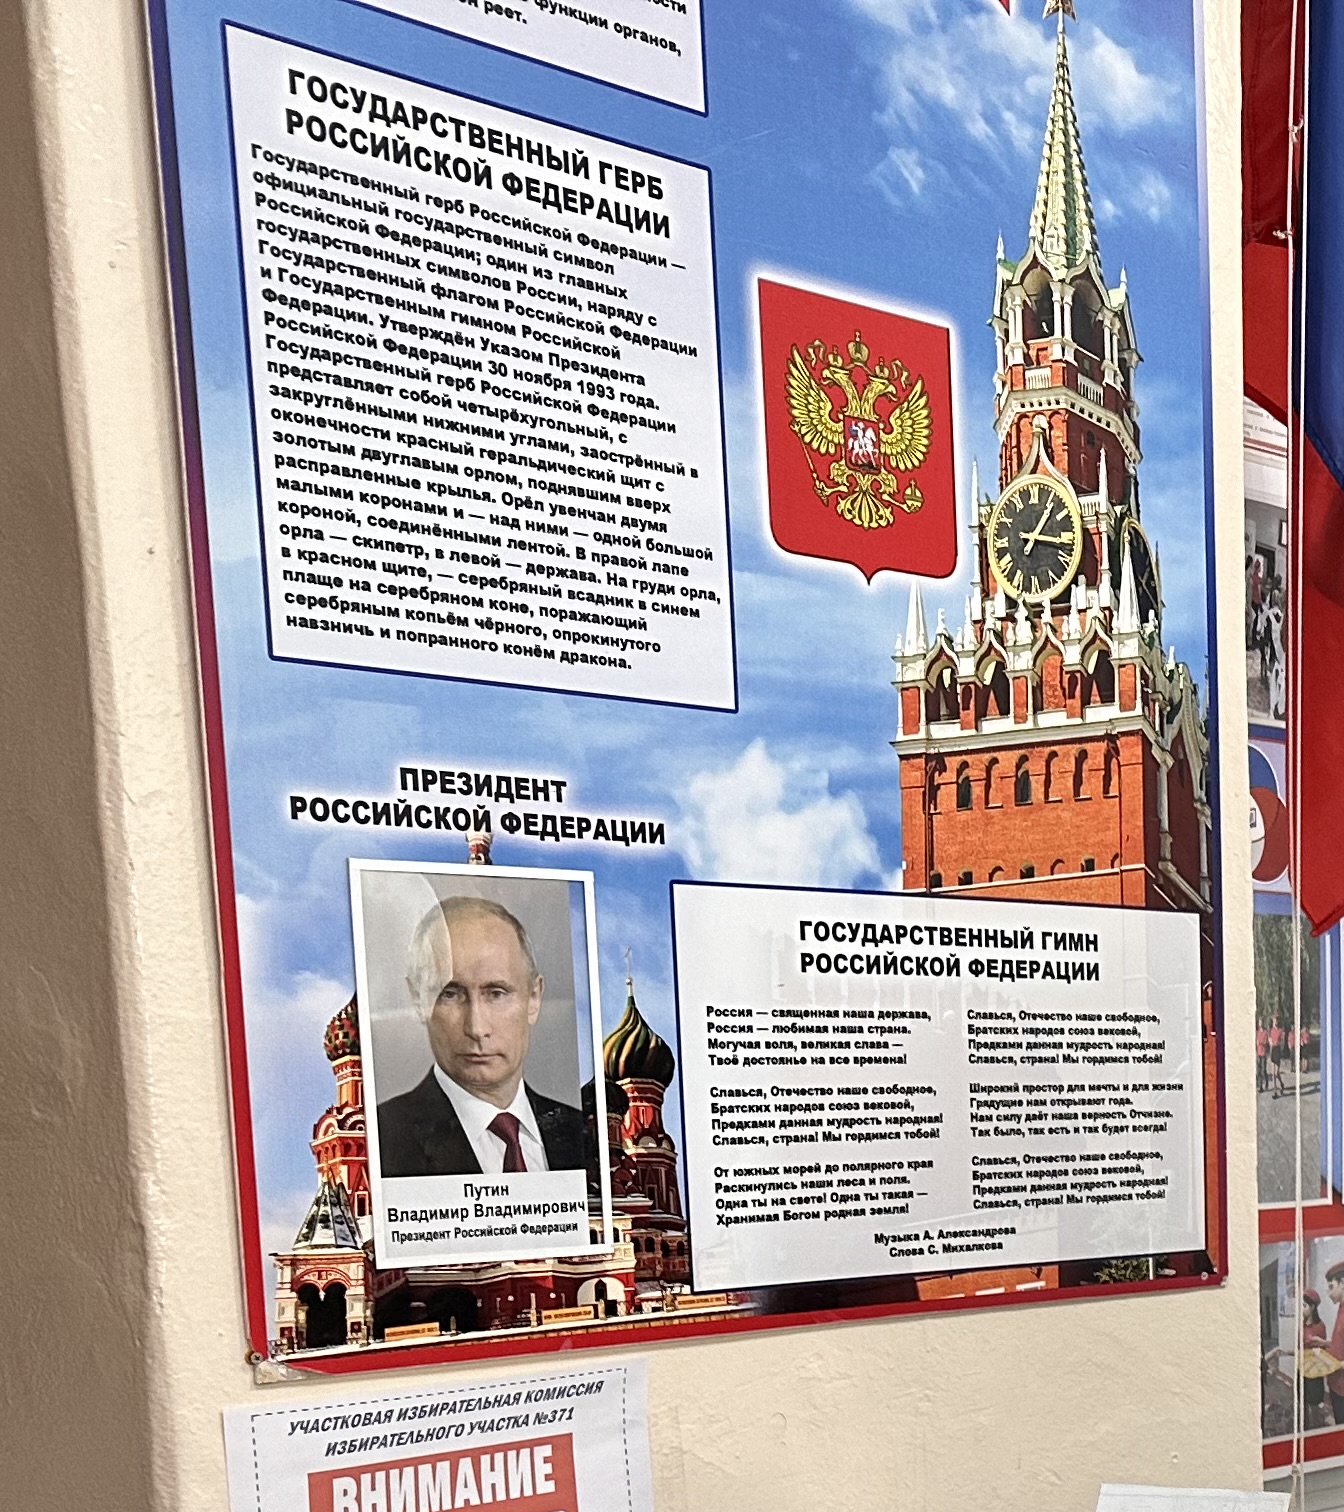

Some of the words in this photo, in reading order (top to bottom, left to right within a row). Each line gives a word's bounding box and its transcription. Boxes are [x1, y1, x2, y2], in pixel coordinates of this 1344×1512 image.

[484, 1, 528, 24] реет.
[613, 22, 682, 56] органов,
[287, 67, 590, 181] ГОСУДАРСТВЕННЫЙ
[597, 159, 664, 201] ГЕРБ
[284, 107, 493, 191] РОССИЙСКОЙ
[500, 171, 671, 239] ФЕДЕРАЦИИ
[249, 142, 420, 203] Государственный
[424, 193, 465, 215] герб
[468, 201, 573, 244] Российской
[575, 231, 668, 269] Федерации
[251, 170, 390, 218] официальный
[393, 207, 549, 259] государственный
[552, 249, 615, 276] символ
[253, 190, 371, 235] Российской
[374, 223, 482, 267] Федерации;
[485, 253, 528, 275] один
[531, 265, 554, 281] из
[557, 271, 629, 300] главных
[255, 217, 422, 270] государственных
[425, 260, 512, 292] символов
[515, 278, 583, 313] России,
[586, 299, 644, 327] наряду
[646, 314, 658, 327] с
[257, 238, 426, 294] Государственный
[429, 281, 500, 311] флагом
[502, 297, 605, 336] Российской
[608, 324, 698, 358] Федерации
[259, 265, 272, 280] и
[276, 265, 446, 321] Государственным
[449, 310, 517, 337] гимном
[520, 323, 621, 361] Российской
[260, 287, 374, 327] Федерации.
[377, 312, 476, 349] Утверждён
[478, 335, 544, 364] Указом
[547, 350, 646, 387] Президента
[263, 309, 378, 350] Российской
[381, 337, 483, 373] Федерации
[487, 359, 508, 378] 30
[512, 367, 572, 392] ноября
[575, 378, 616, 401] 1993
[618, 391, 660, 411] года.
[264, 332, 432, 383] Государственный
[435, 372, 476, 393] герб
[479, 378, 583, 415] Российской
[585, 402, 677, 434] Федерации
[266, 359, 395, 397] представляет
[398, 387, 453, 410] собой
[456, 398, 614, 445] четырёхугольный,
[617, 432, 628, 444] с
[267, 383, 418, 425] закруглёнными
[422, 414, 506, 442] нижними
[508, 431, 575, 458] углами,
[578, 445, 686, 477] заострённый
[689, 466, 699, 479] в
[399, 766, 567, 803] ПРЕЗИДЕНТ
[289, 795, 491, 833] РОССИЙСКОЙ
[501, 812, 666, 847] ФЕДЕРАЦИИ
[798, 919, 1035, 950] ГОСУДАРСТВЕННЫЙ
[1040, 930, 1099, 953] ГИМН
[799, 951, 961, 978] РОССИЙСКОЙ
[967, 957, 1100, 984] ФЕДЕРАЦИИ
[708, 1085, 767, 1100] Славься,
[769, 1084, 834, 1097] Отечество
[870, 1082, 937, 1097] свободное,
[709, 1101, 772, 1117] Братских
[773, 1101, 826, 1116] народов
[862, 1097, 915, 1113] вековой,
[710, 1117, 776, 1133] Предками
[777, 1117, 824, 1131] данная
[825, 1116, 883, 1130] мудрость
[884, 1111, 944, 1128] народная!
[711, 1133, 770, 1147] Славься,
[771, 1130, 819, 1147] страна!
[844, 1130, 902, 1144] гордимся
[902, 1126, 941, 1140] тобой!
[464, 1183, 509, 1198] Путин
[732, 1165, 781, 1178] южных
[782, 1161, 822, 1177] морей
[841, 1160, 905, 1174] полярного
[387, 1205, 469, 1224] Владимир
[473, 1198, 585, 1219] Владимирович
[391, 1228, 451, 1242] Президент
[454, 1224, 517, 1240] Российской
[520, 1221, 578, 1236] Федерации
[715, 1212, 780, 1228] Хранимая
[782, 1208, 821, 1222] Богом
[823, 1207, 867, 1222] родная
[868, 1201, 910, 1216] земля!
[873, 1231, 921, 1246] Музыка
[936, 1225, 1017, 1240] Александрова
[888, 1245, 925, 1258] Слова
[941, 1241, 1004, 1254] Михалкова
[288, 1409, 393, 1436] УЧАСТКОВАЯ
[396, 1392, 522, 1421] ИЗБИРАТЕЛЬНАЯ
[524, 1380, 604, 1404] КОМИССИЯ
[324, 1424, 464, 1457] ИЗБИРАТЕЛЬНОГО
[467, 1413, 529, 1437] УЧАСТКА
[532, 1407, 575, 1425] №371
